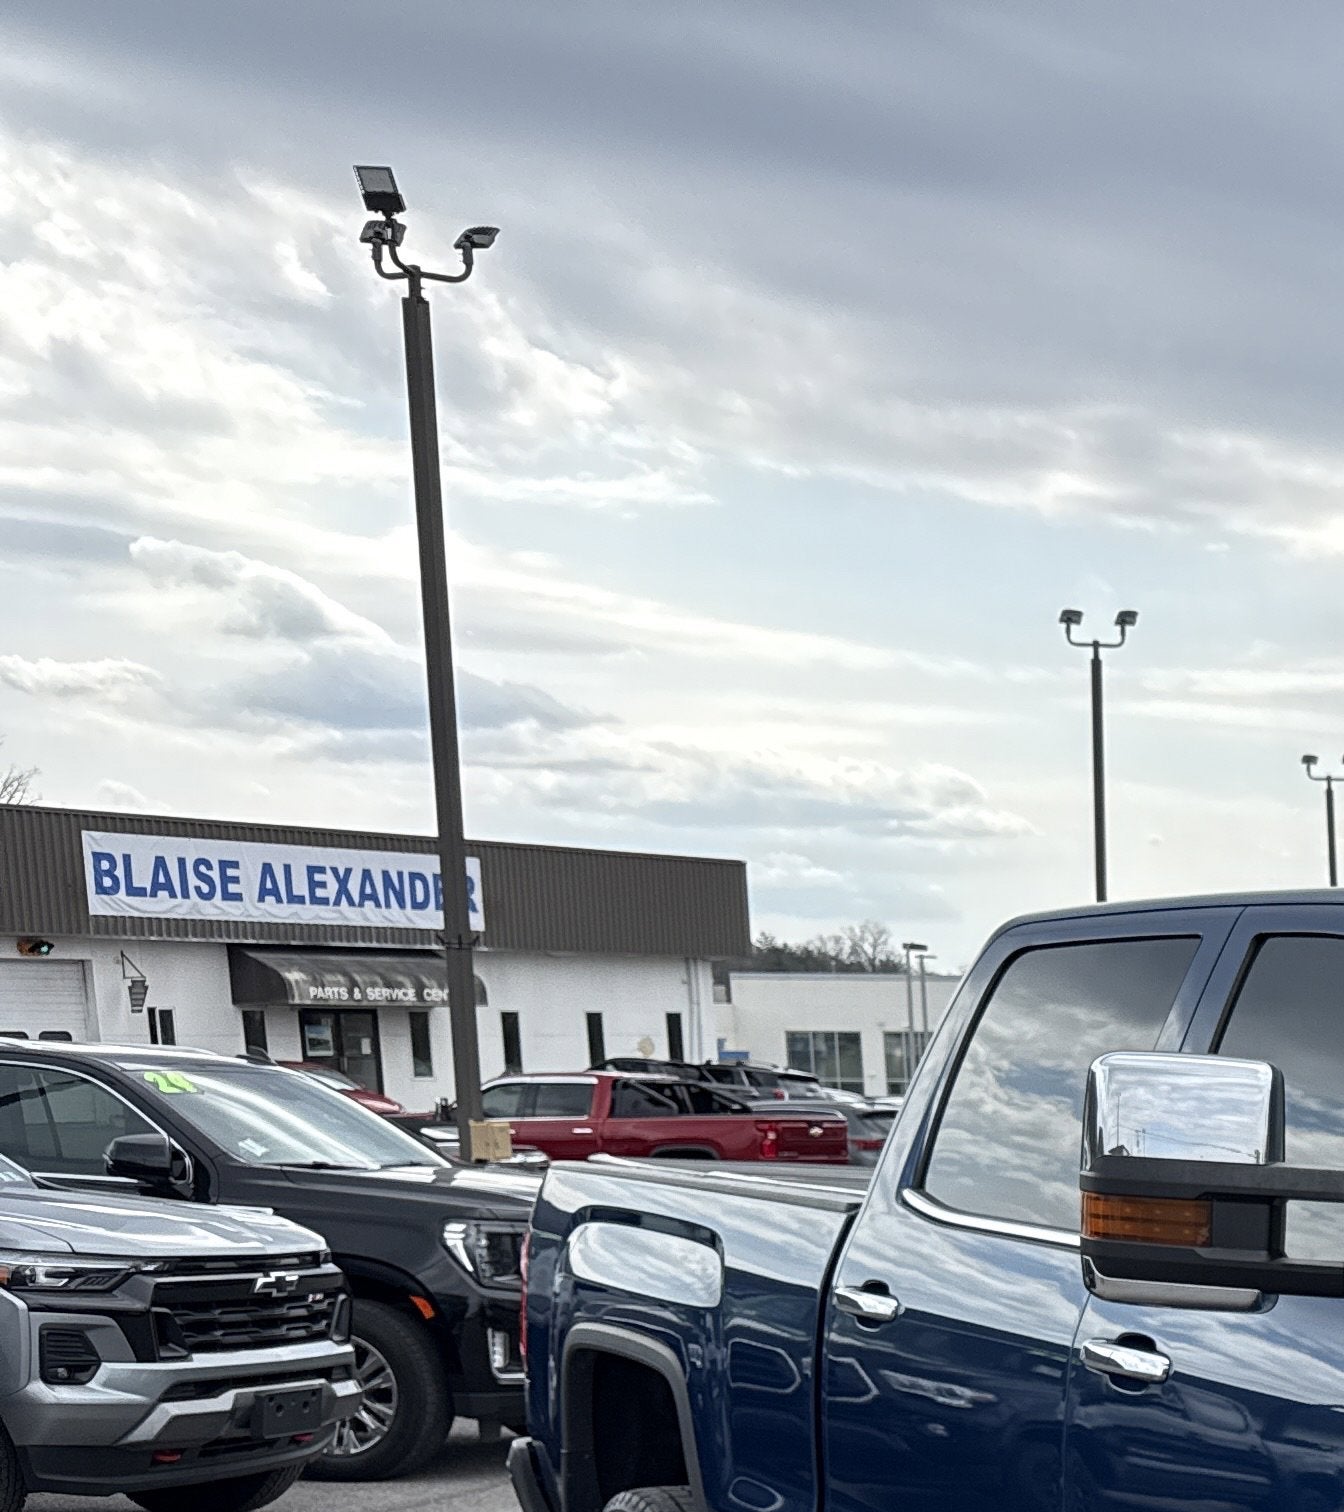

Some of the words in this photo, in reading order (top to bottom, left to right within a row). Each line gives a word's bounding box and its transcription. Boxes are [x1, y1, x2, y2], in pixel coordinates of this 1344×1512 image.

[91, 851, 244, 902] BLAISE
[309, 986, 349, 1001] PARTS
[353, 987, 362, 1001] &
[366, 987, 417, 1001] SERVICE
